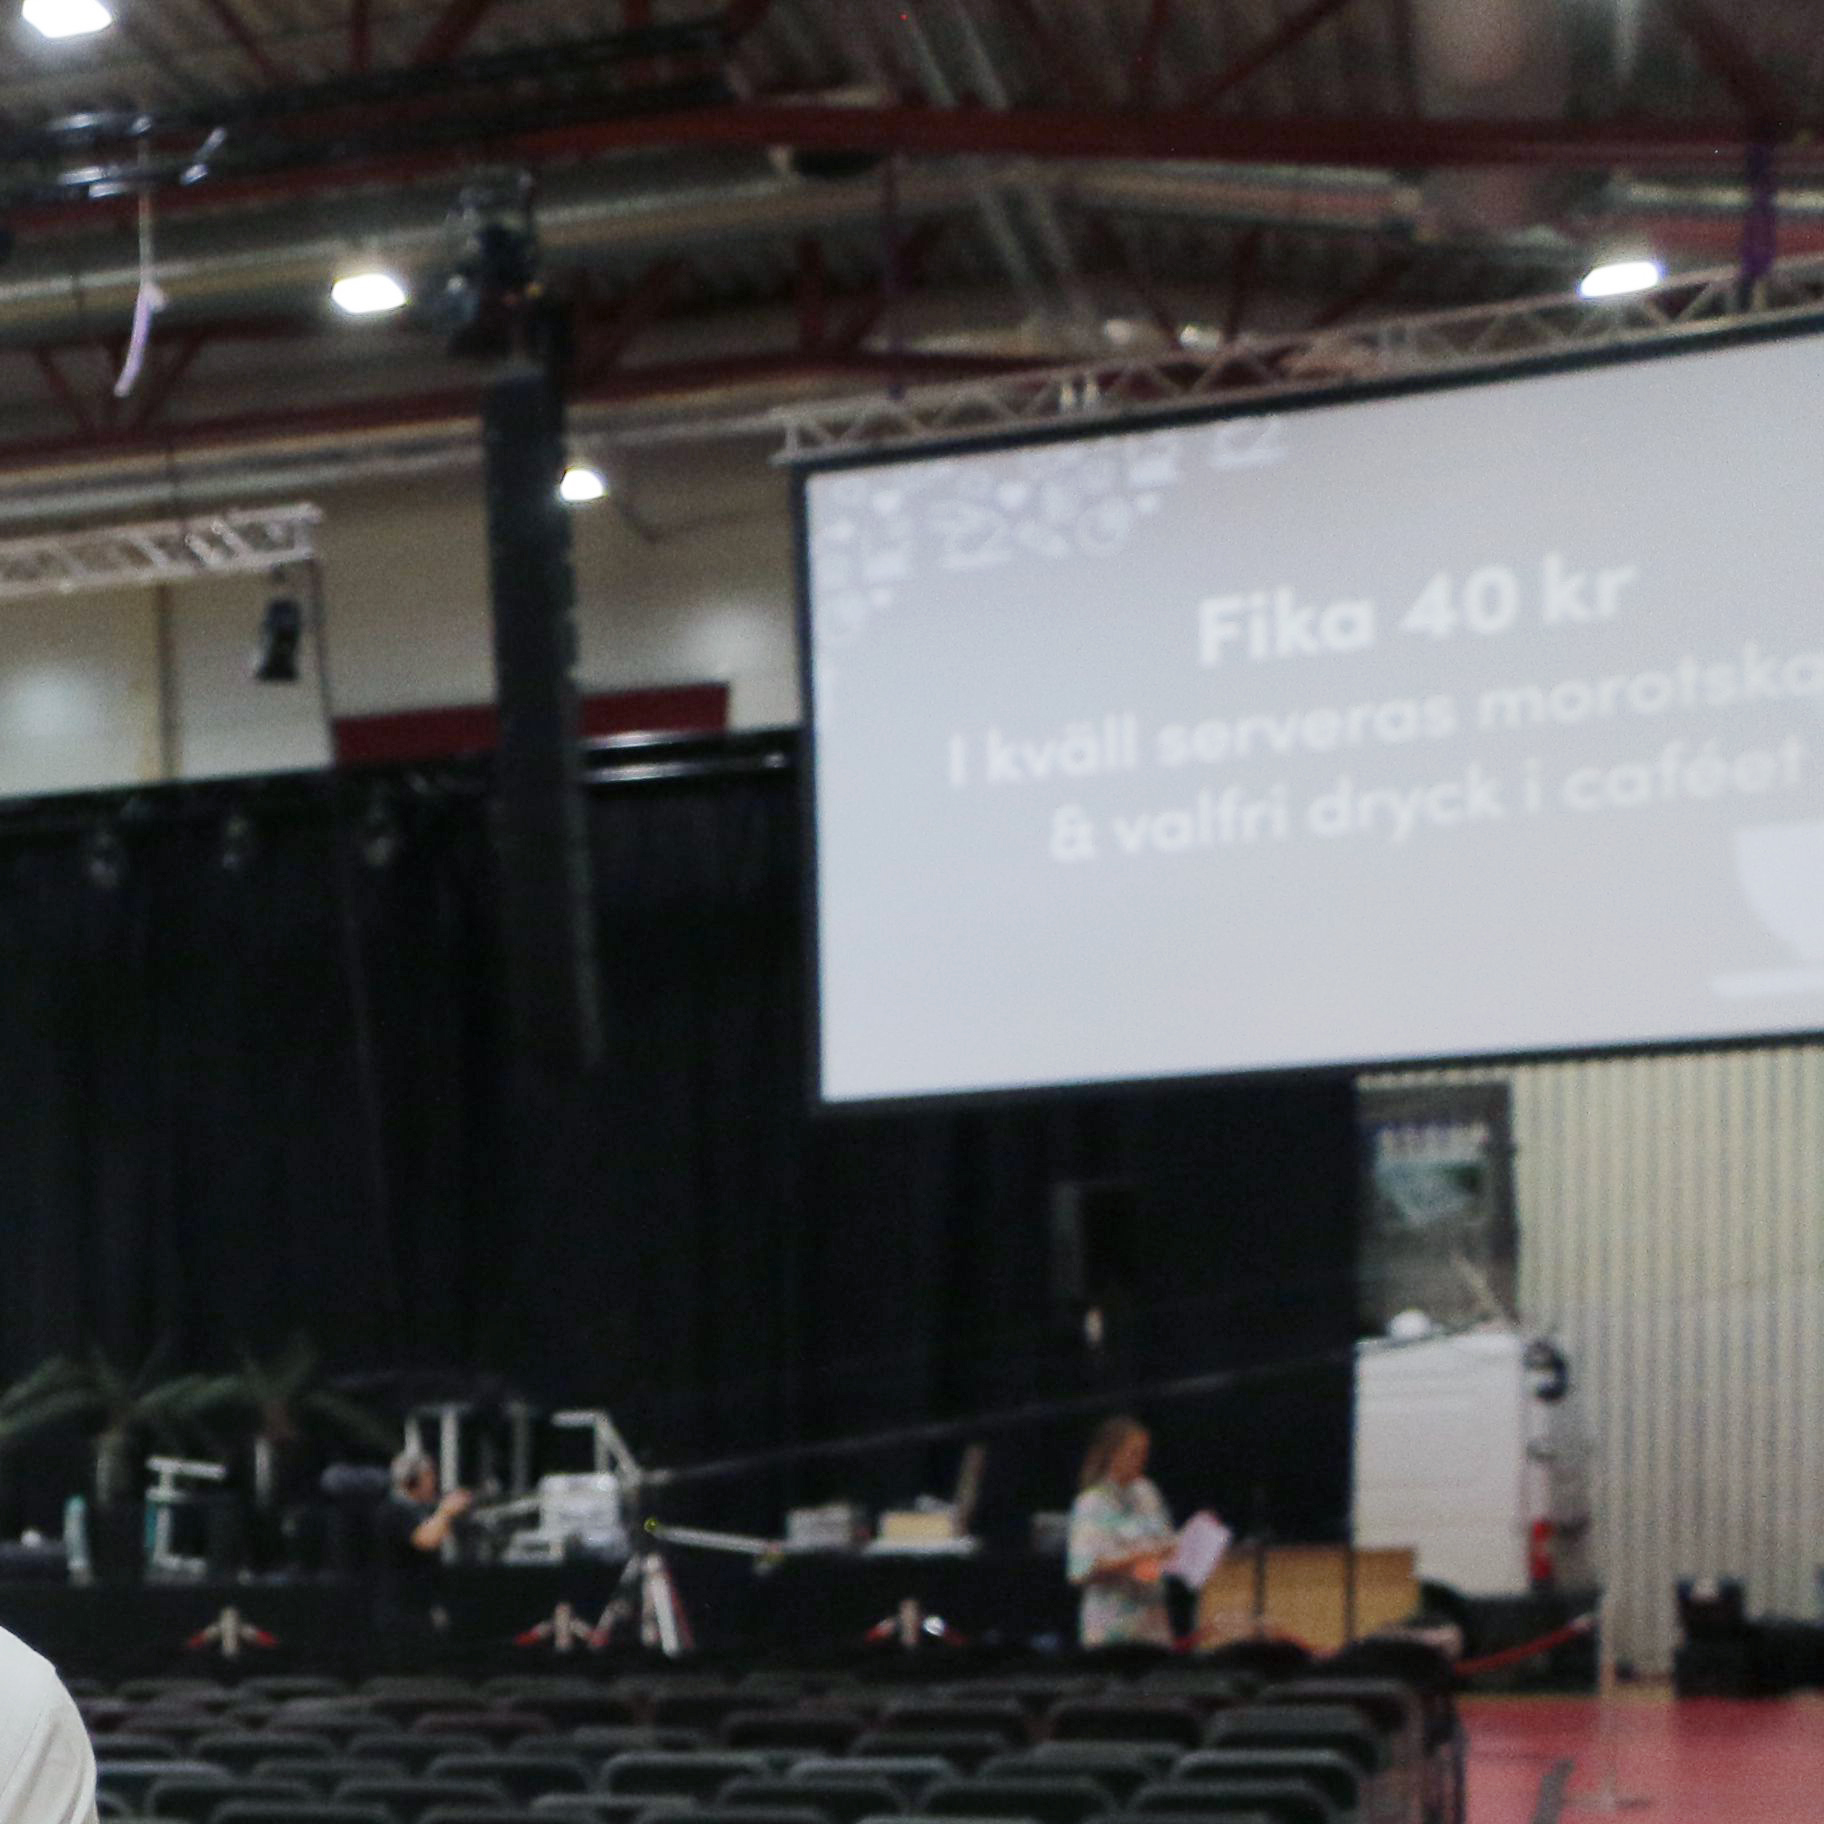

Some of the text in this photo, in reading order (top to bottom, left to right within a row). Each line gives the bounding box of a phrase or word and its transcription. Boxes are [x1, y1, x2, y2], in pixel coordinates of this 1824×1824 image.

[1198, 552, 1637, 667] Fika 40 kr
[951, 731, 966, 788] I
[987, 711, 1139, 785] kväll
[1156, 692, 1457, 768] serveras
[1052, 802, 1095, 862] &
[1114, 782, 1288, 855] valfri
[1308, 758, 1502, 845] dryck
[1524, 757, 1542, 814] i
